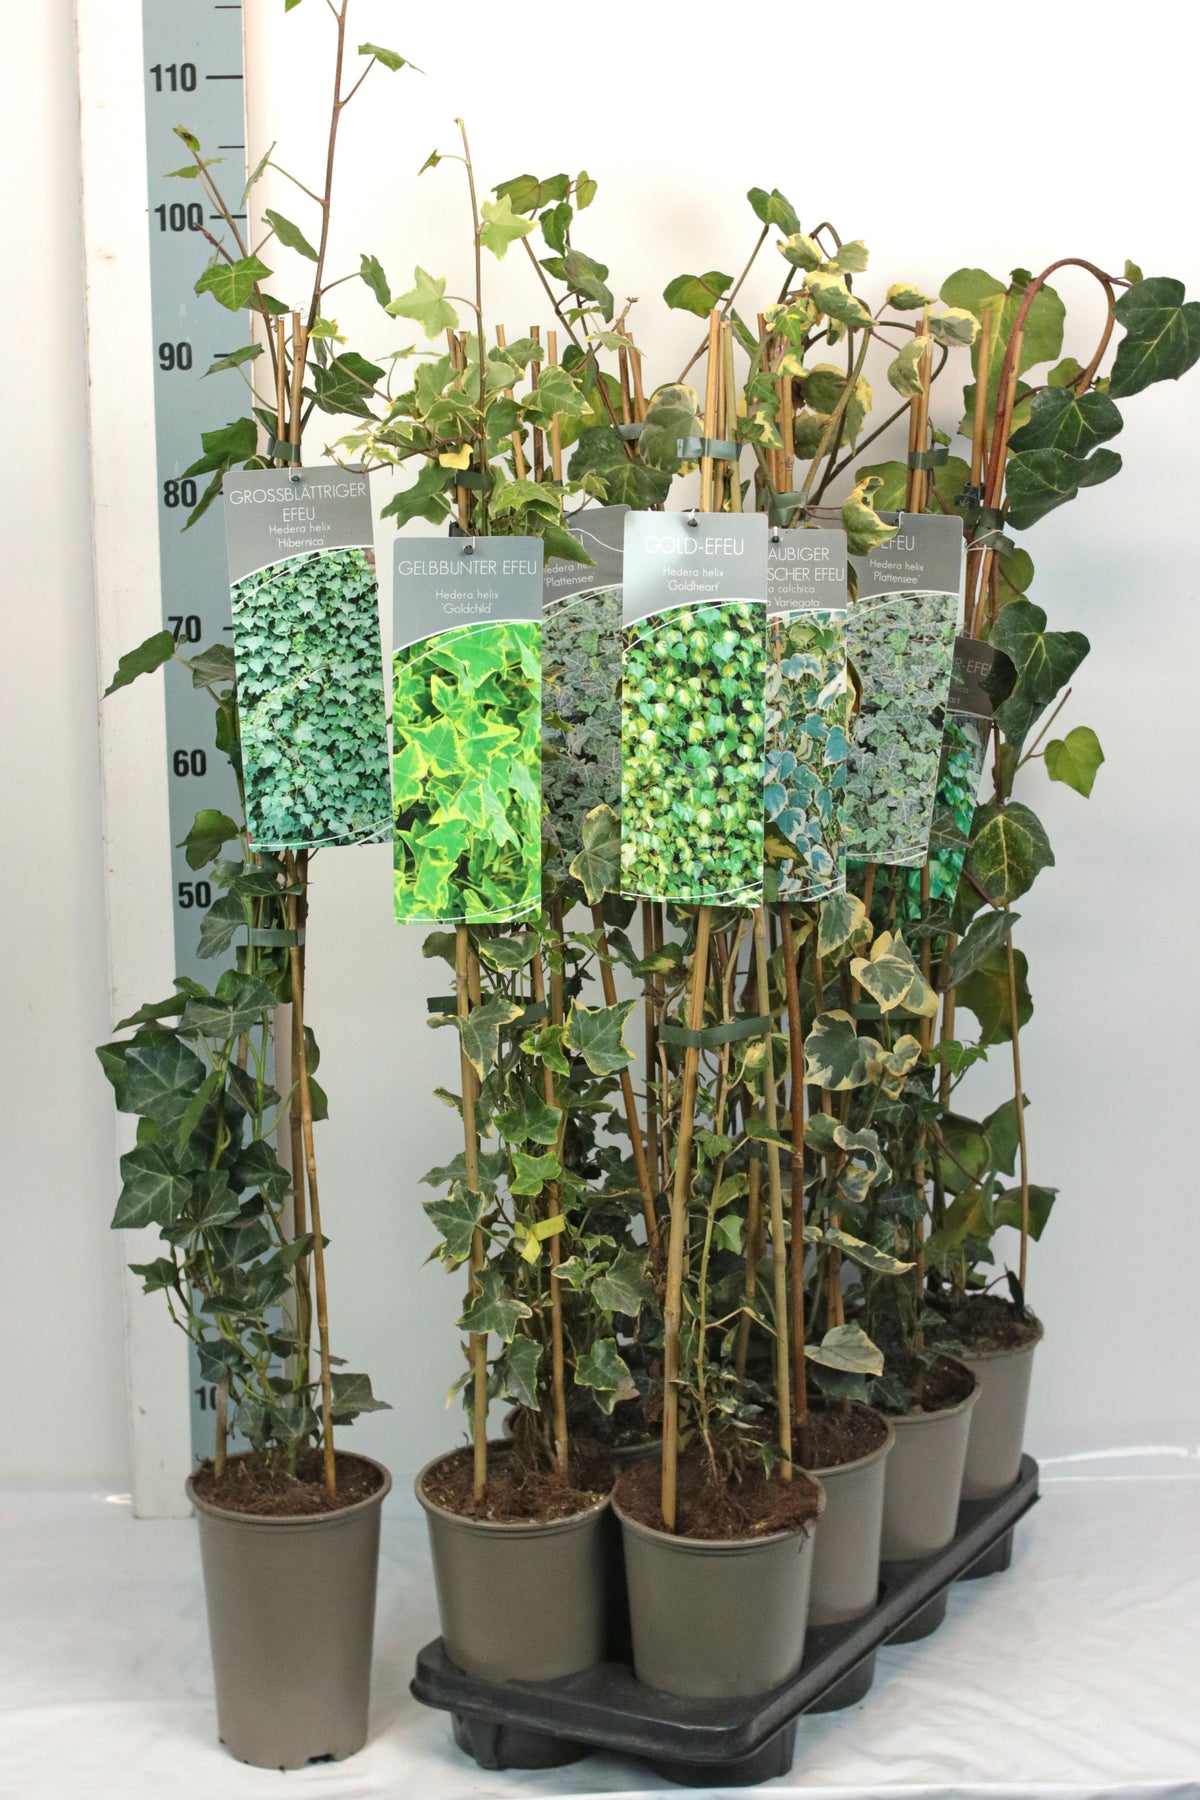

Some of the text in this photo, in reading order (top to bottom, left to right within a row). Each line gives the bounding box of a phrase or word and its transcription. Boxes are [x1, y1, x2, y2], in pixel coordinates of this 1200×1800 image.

[150, 63, 197, 92] 110
[154, 203, 204, 232] 100
[158, 342, 193, 371] 90
[163, 479, 198, 508] 80
[229, 482, 367, 505] GROSSBLÄTTRIGER
[282, 507, 316, 522] EFEU
[269, 522, 331, 535] Hedera helix
[643, 535, 745, 556] GOLD-EFEU
[767, 547, 830, 561] AUBIGER
[398, 560, 538, 576] GELBBUNTER EFEU
[545, 564, 575, 574] edera
[663, 567, 724, 578] Hedera helix
[869, 559, 924, 571] Hedera helix
[767, 567, 845, 581] SCHER EFEU
[435, 589, 499, 600] Hedera helix
[777, 584, 816, 593] colchica
[168, 615, 201, 643] 70
[173, 749, 207, 777] 60
[178, 881, 211, 909] 50
